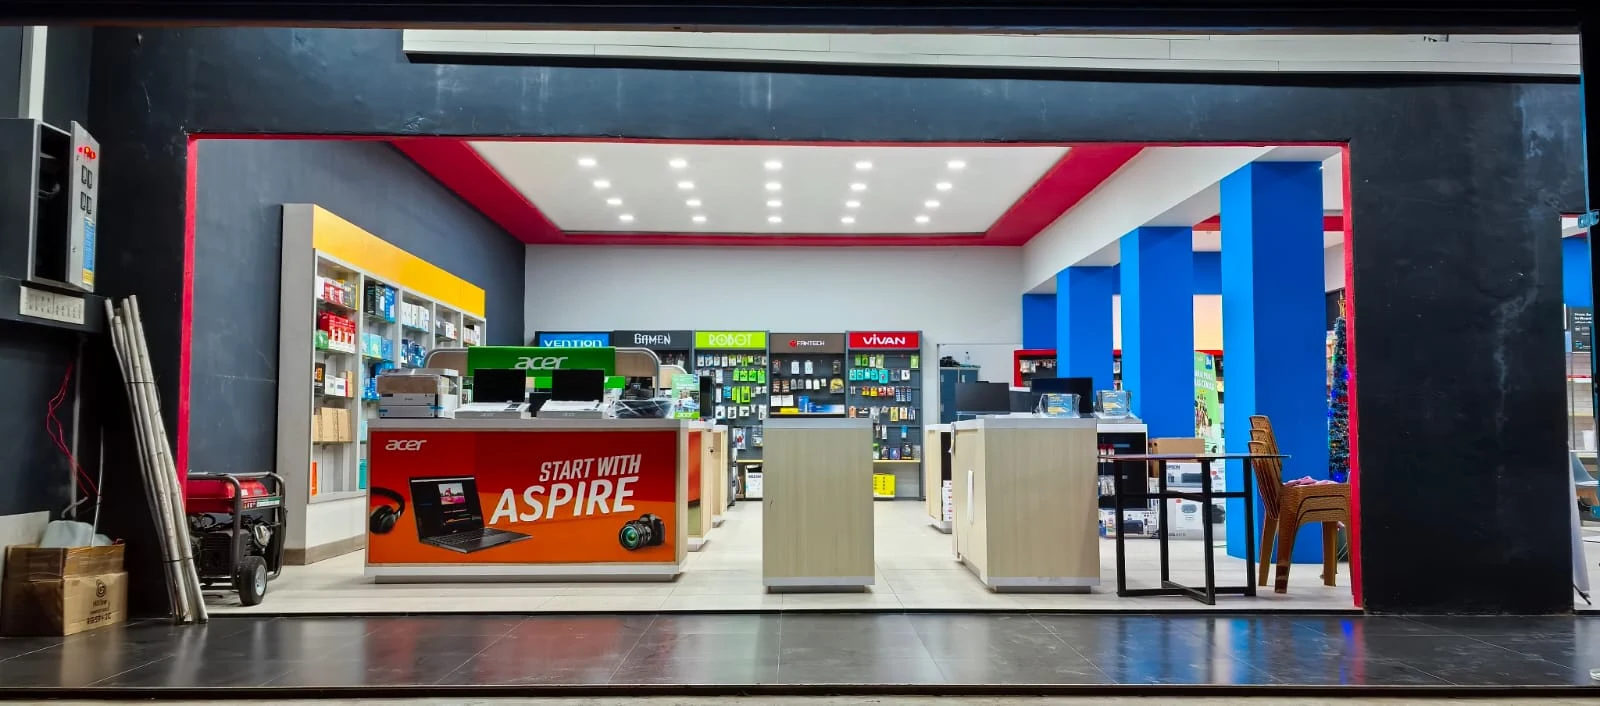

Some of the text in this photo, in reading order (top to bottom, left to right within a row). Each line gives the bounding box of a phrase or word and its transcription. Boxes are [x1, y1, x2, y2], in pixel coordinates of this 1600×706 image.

[544, 339, 603, 347] VENTION
[634, 333, 671, 345] GAMEN
[709, 334, 752, 346] ROBOT
[514, 356, 569, 370] acer
[385, 439, 427, 451] acer
[539, 453, 642, 482] START WITH
[488, 476, 639, 525] ASPIRE
